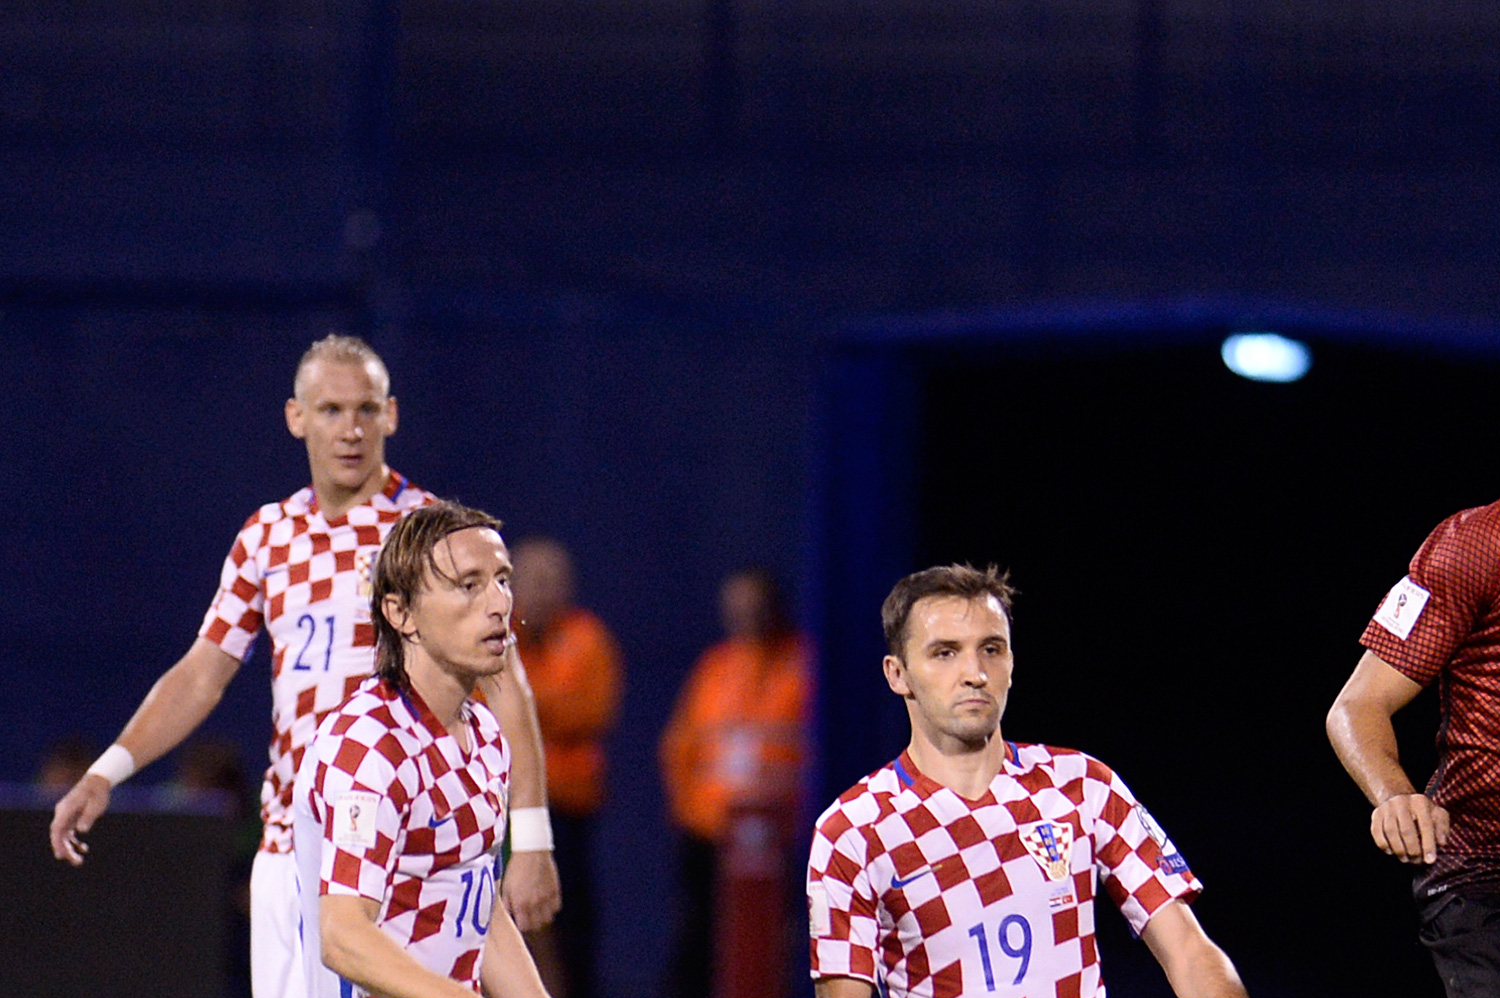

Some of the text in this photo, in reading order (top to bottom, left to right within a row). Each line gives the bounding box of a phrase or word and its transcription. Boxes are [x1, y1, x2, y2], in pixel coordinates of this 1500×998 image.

[294, 615, 335, 670] 21
[455, 865, 495, 939] 10
[968, 913, 1033, 992] 19
